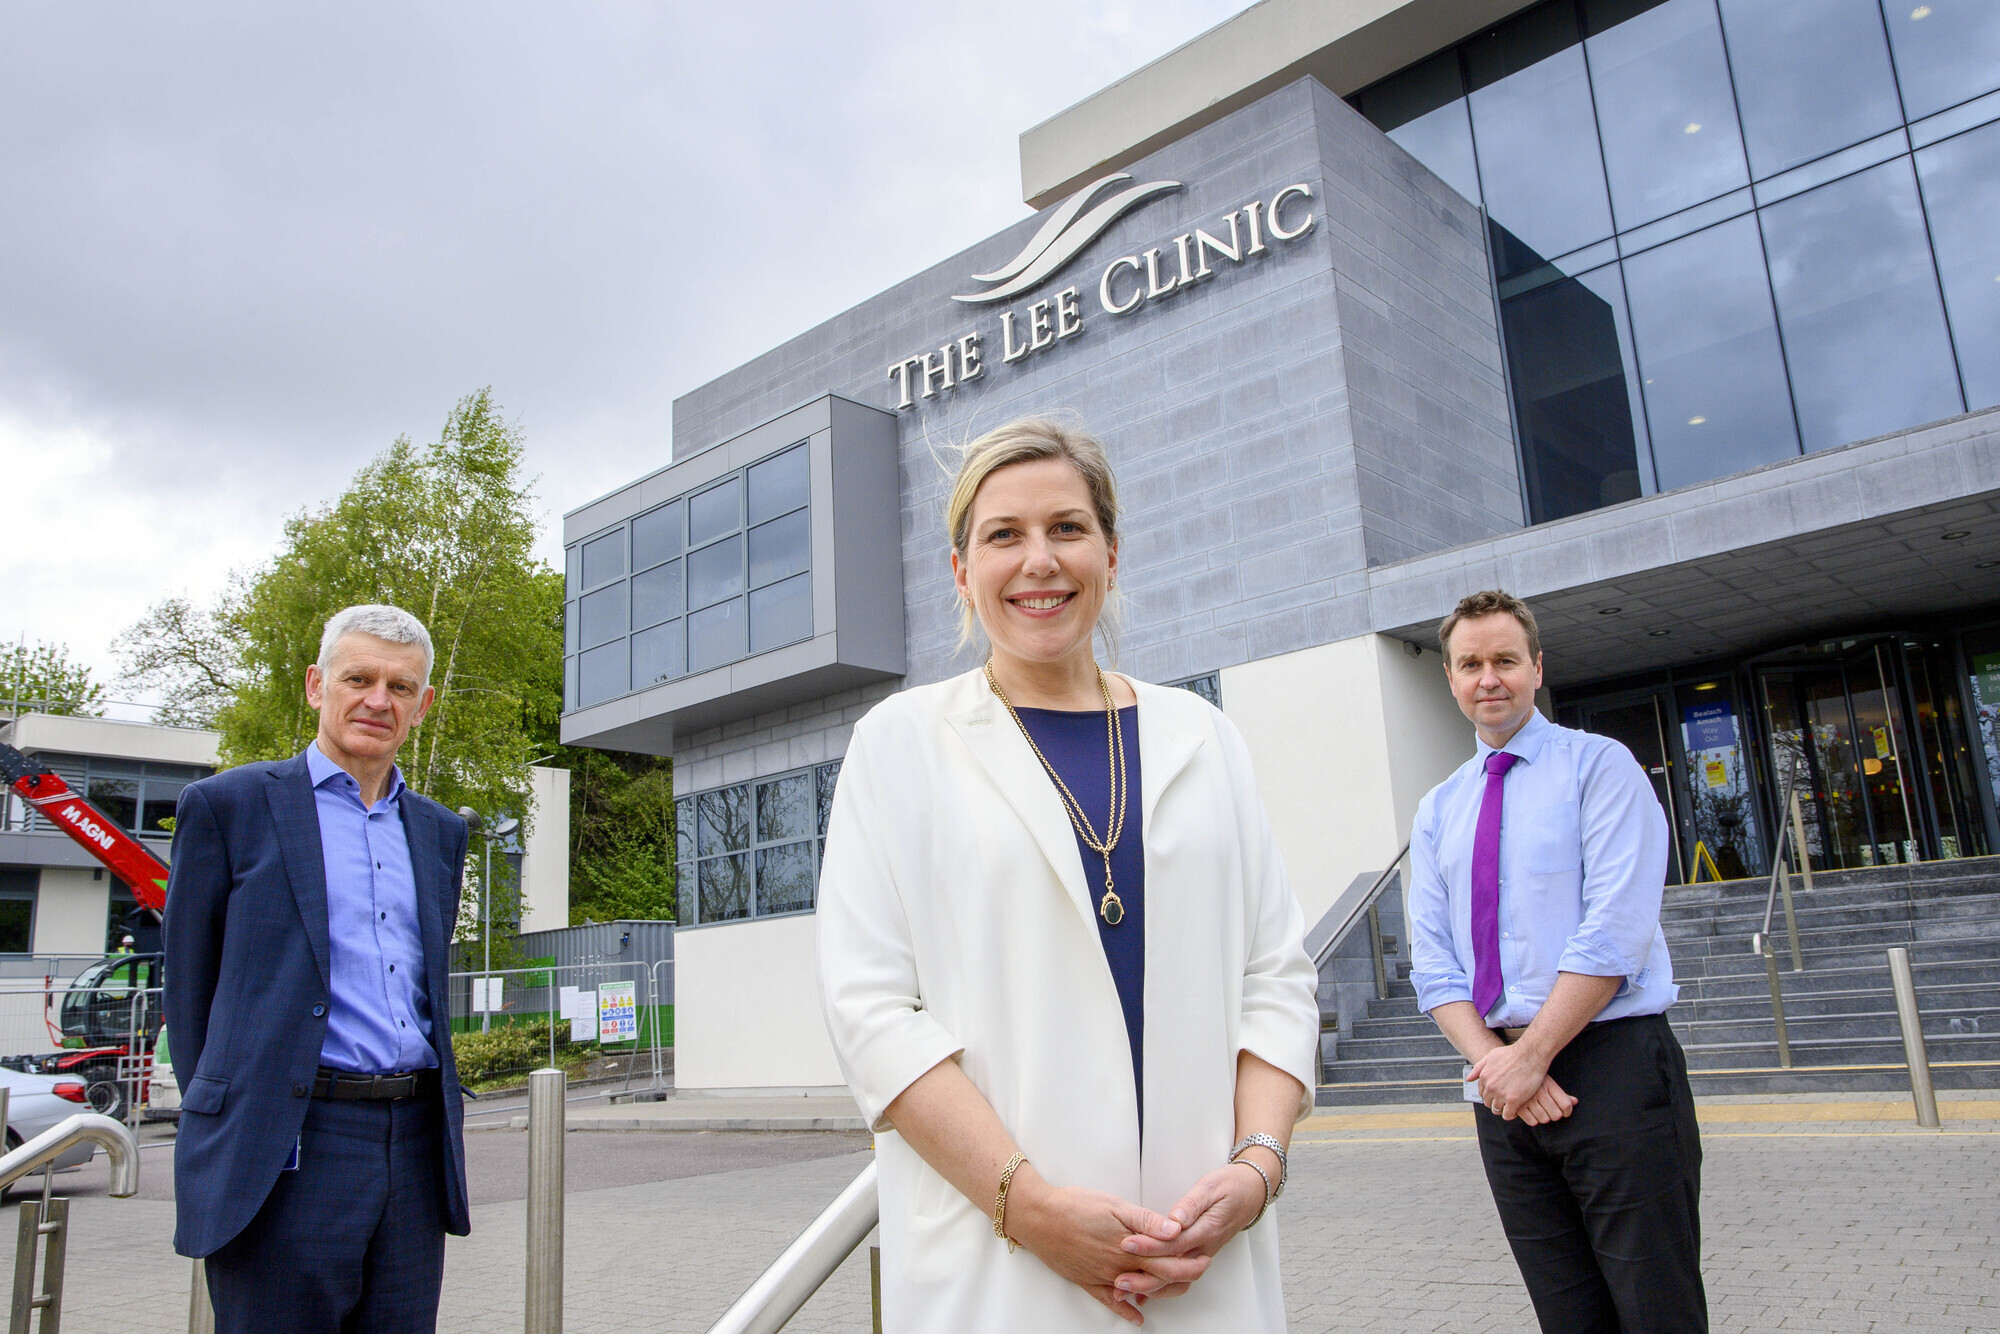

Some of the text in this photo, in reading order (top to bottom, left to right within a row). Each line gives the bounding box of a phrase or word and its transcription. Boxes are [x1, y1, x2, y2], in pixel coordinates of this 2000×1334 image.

[887, 182, 1316, 410] THE LEE CLINIC
[61, 805, 116, 850] MAGNI
